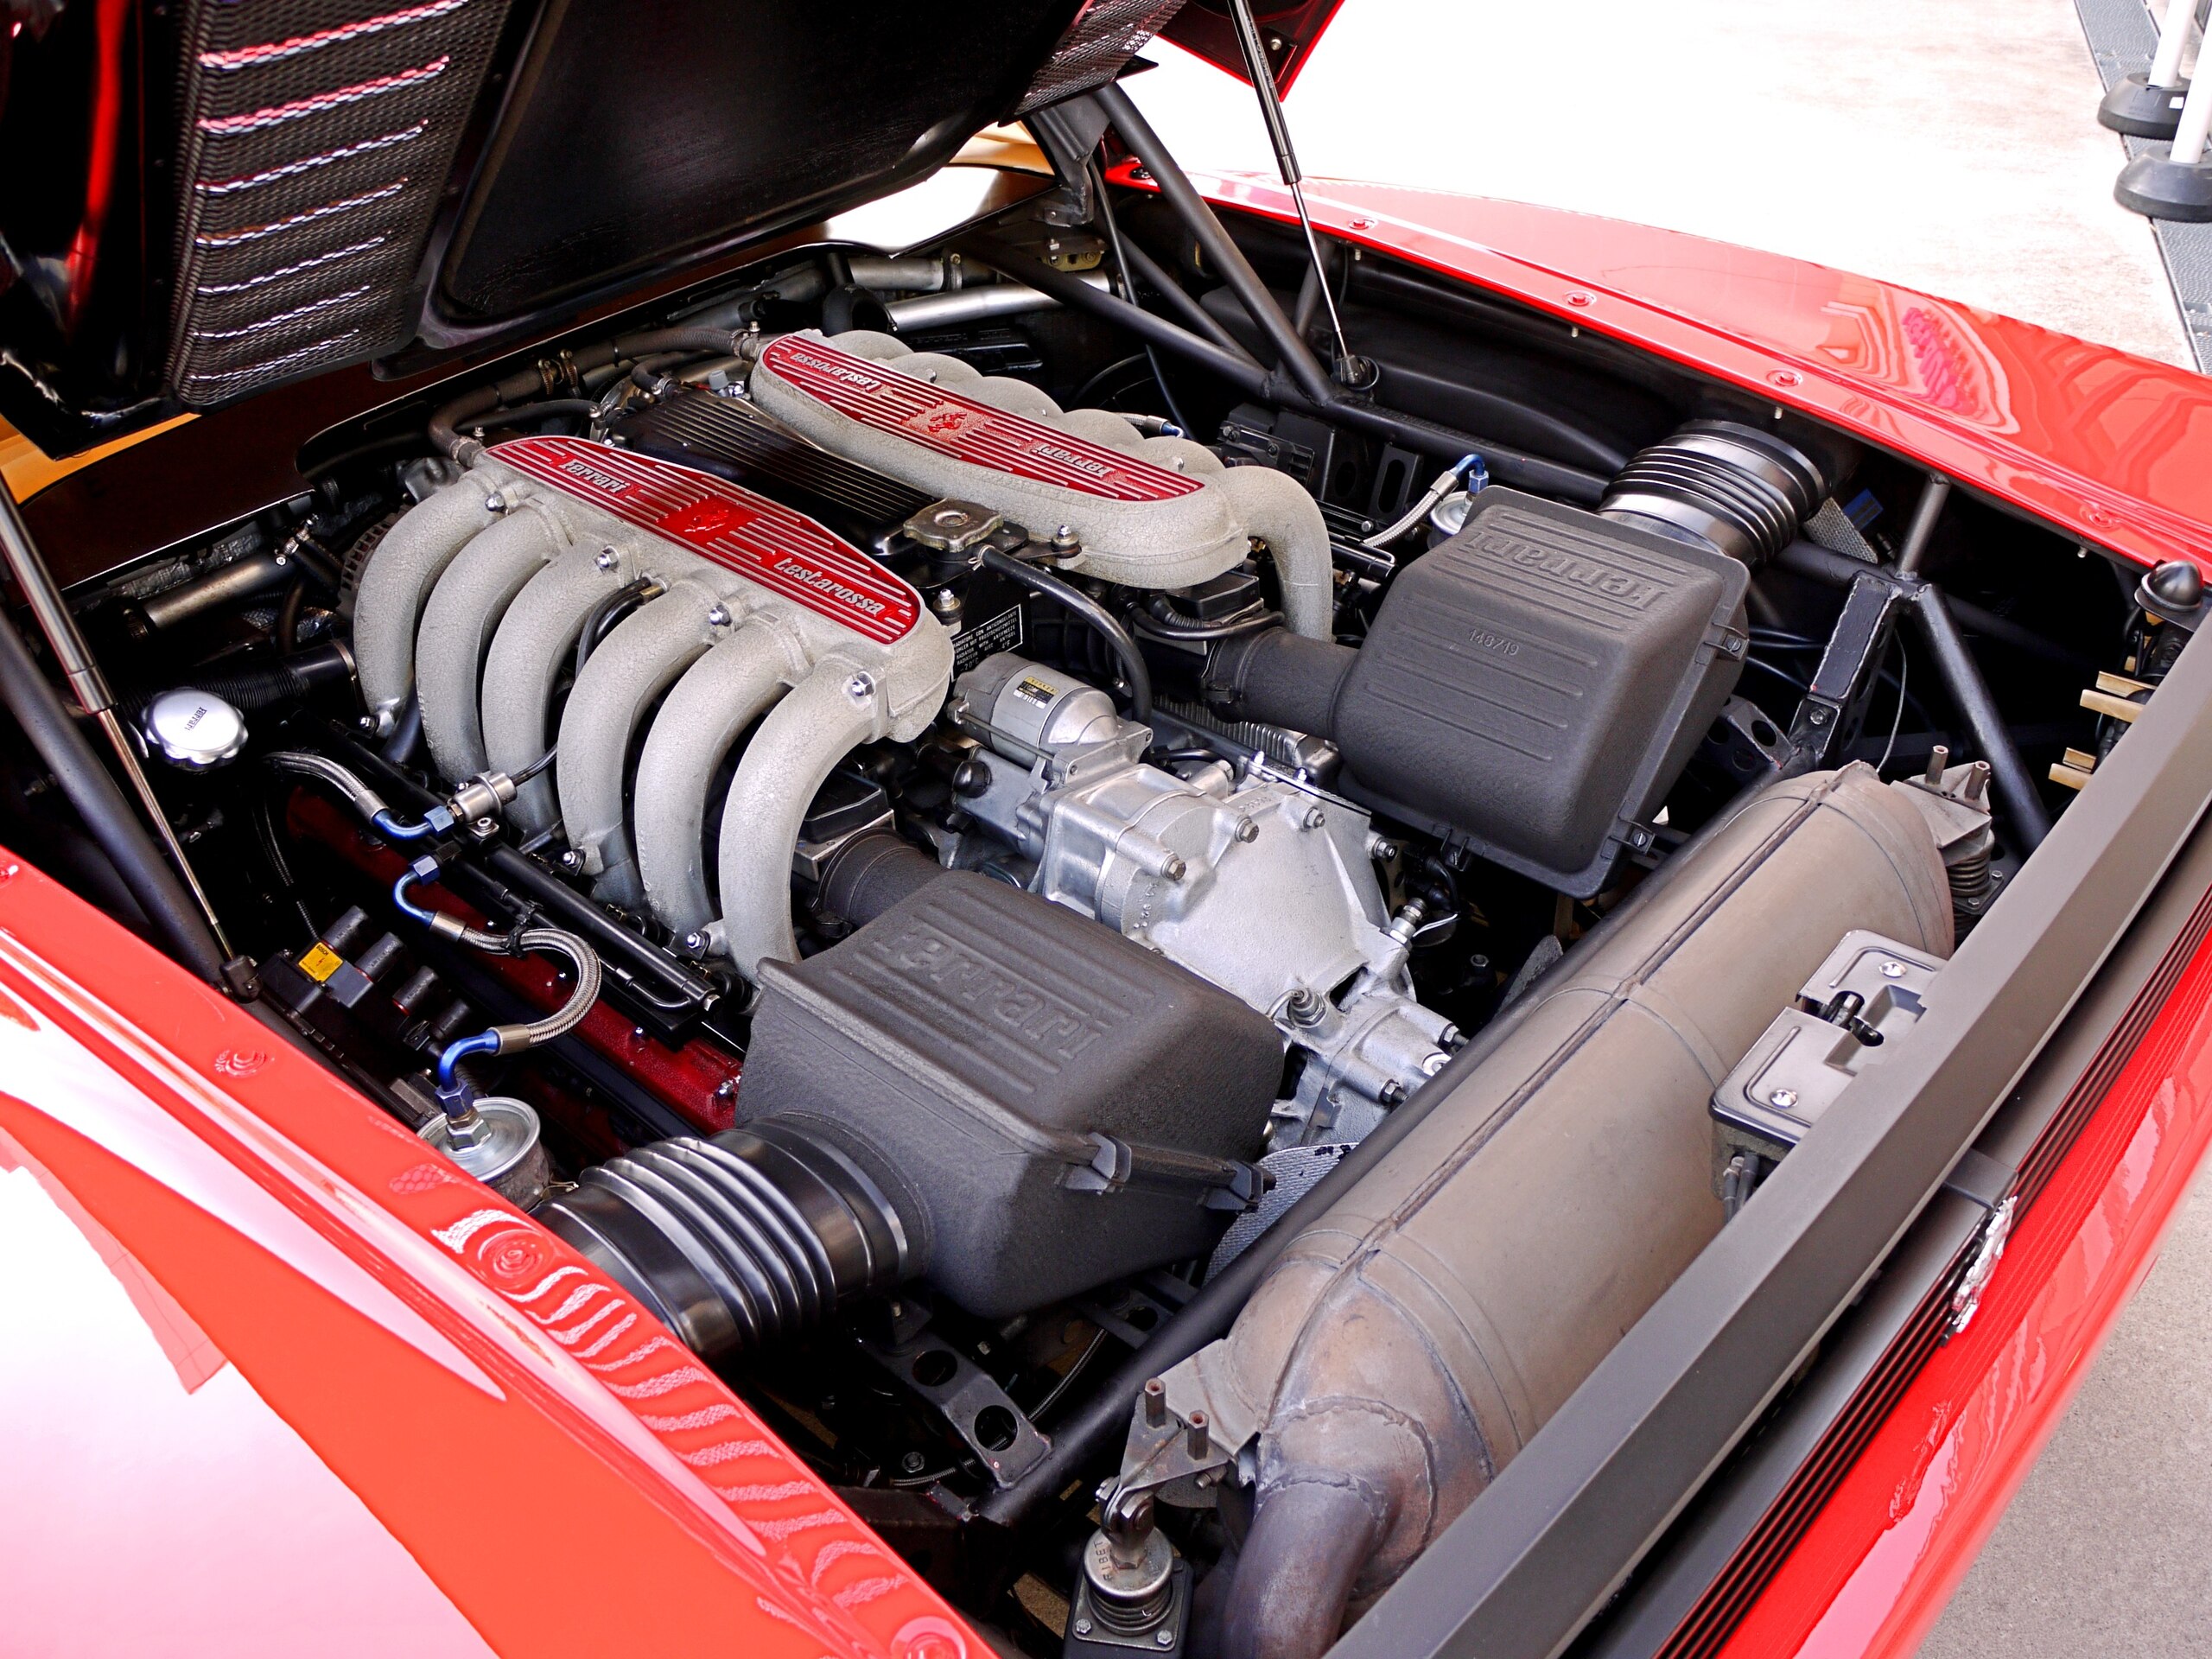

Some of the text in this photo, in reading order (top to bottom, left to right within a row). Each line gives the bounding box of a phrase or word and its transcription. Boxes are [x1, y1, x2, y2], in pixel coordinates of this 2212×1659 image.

[790, 348, 881, 390] testarossa
[558, 459, 631, 493] Ferrari
[1032, 442, 1116, 478] Ferrari
[773, 557, 886, 616] testarossa
[1460, 531, 1669, 608] Ferrari
[1468, 628, 1521, 657] 148719
